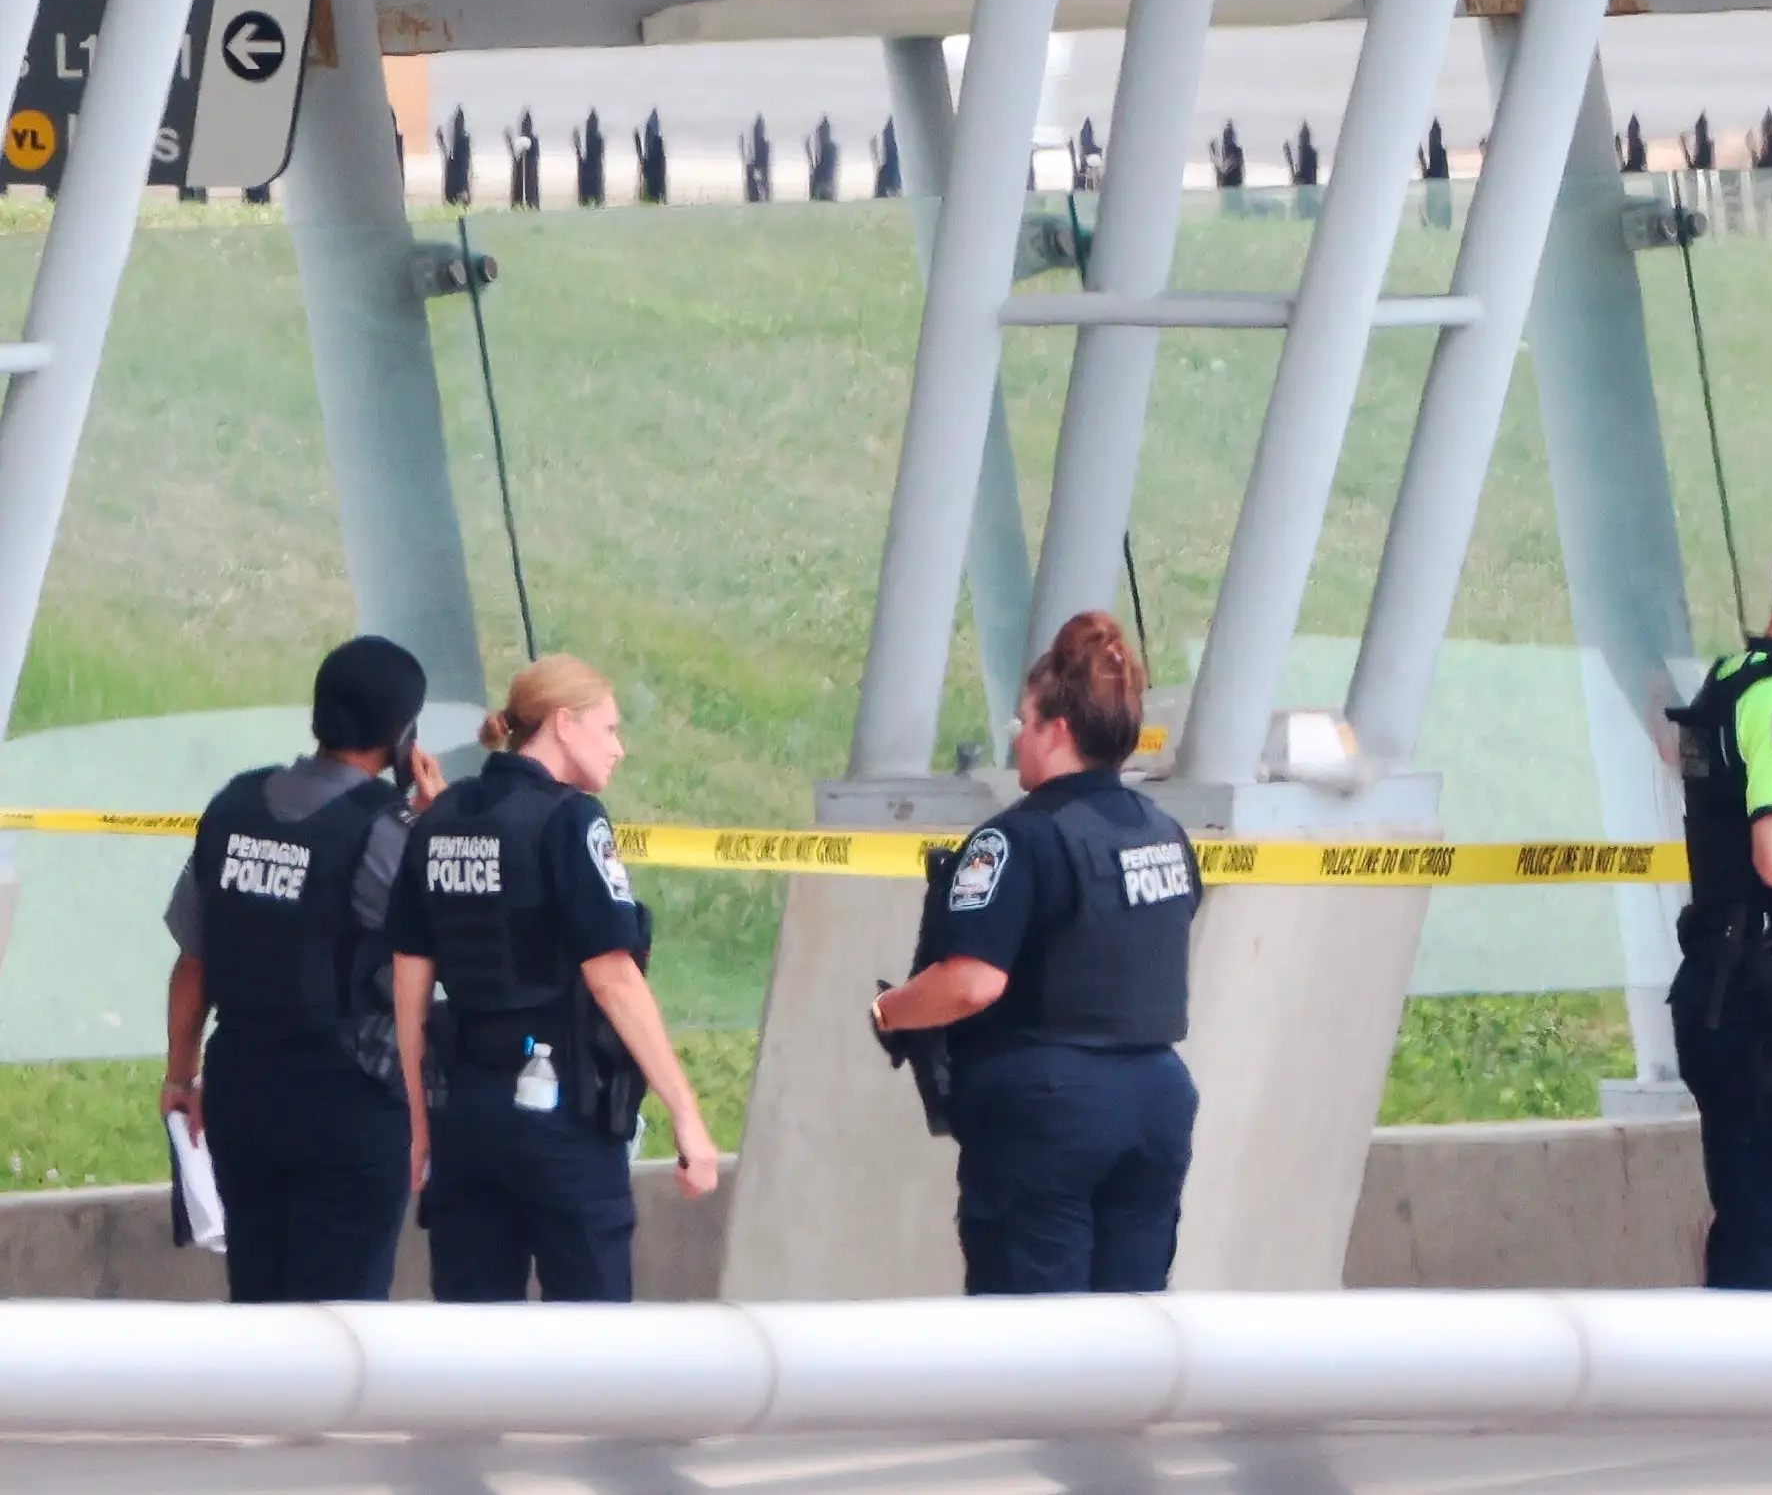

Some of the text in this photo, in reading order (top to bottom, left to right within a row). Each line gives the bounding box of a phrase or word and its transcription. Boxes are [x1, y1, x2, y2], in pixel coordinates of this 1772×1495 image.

[11, 126, 47, 151] YL
[227, 833, 311, 868] PENTAGON
[427, 834, 501, 859] PENTAGON
[1118, 841, 1184, 872] PENTAGON
[1320, 847, 1357, 876] POLICE
[1419, 846, 1456, 877] CROSS
[1515, 846, 1557, 876] POLICE
[220, 857, 307, 899] POLICE
[426, 858, 502, 893] POLICE
[1124, 862, 1190, 907] POLICE
